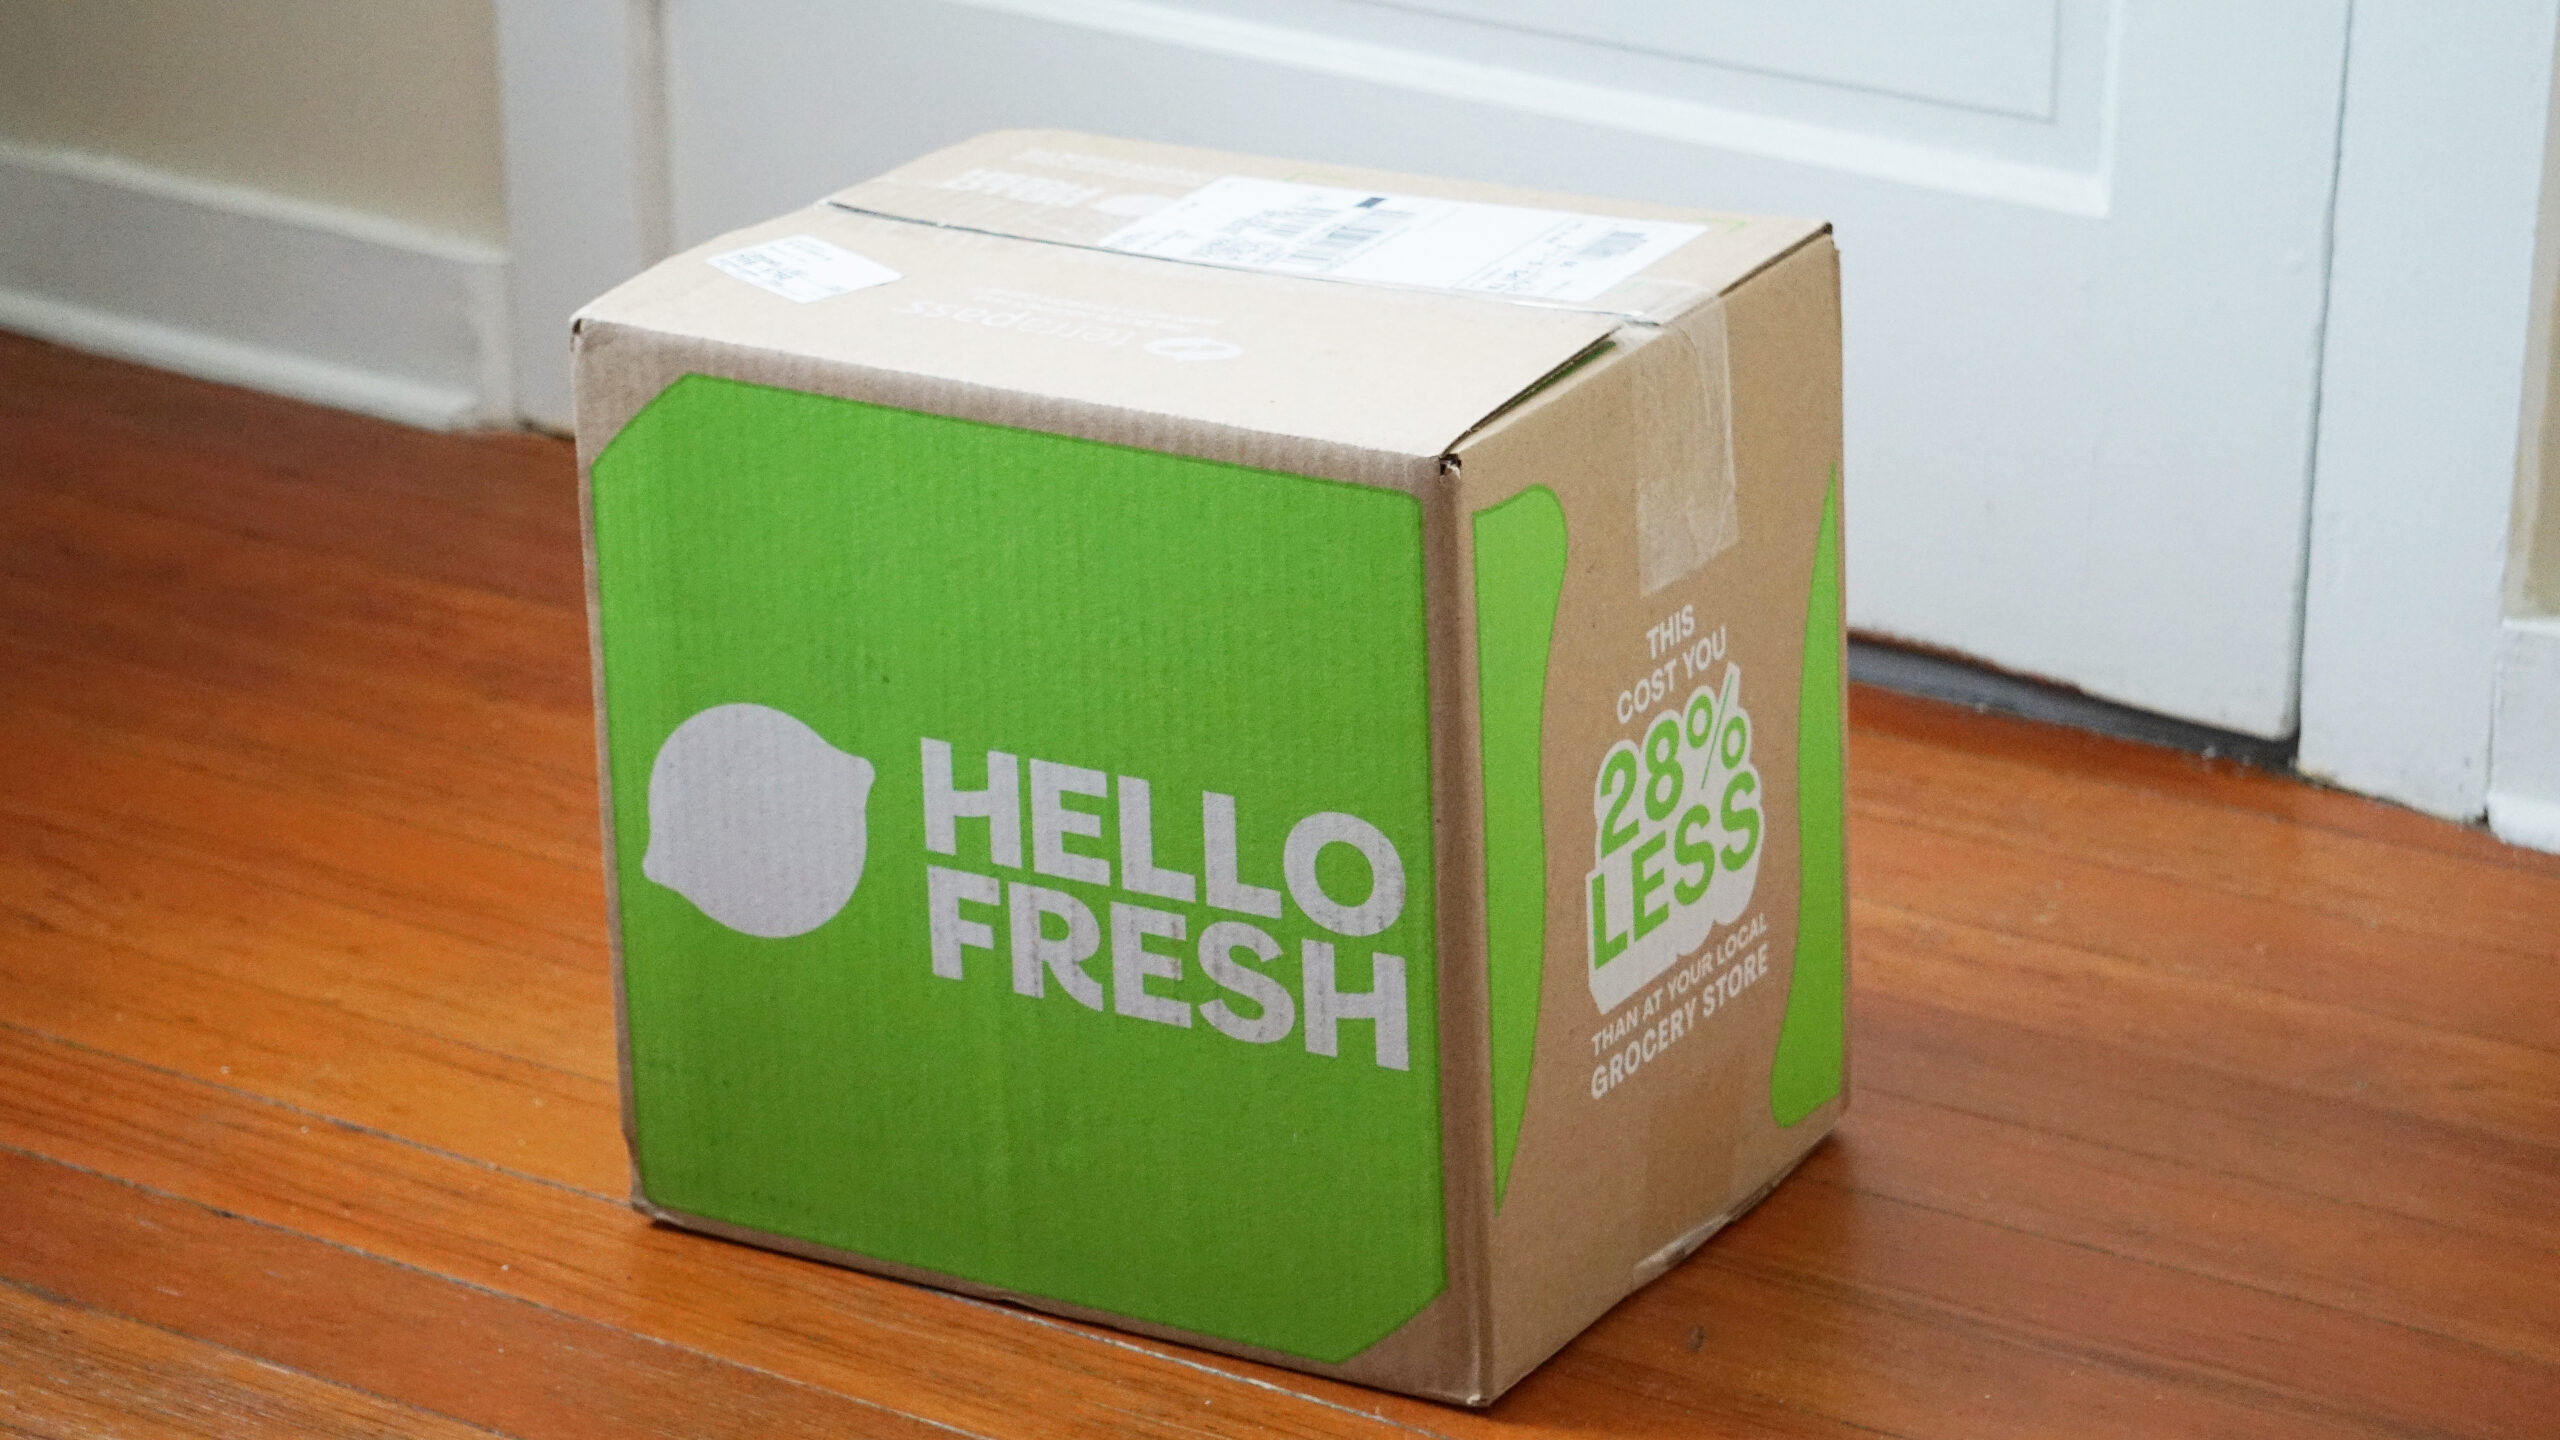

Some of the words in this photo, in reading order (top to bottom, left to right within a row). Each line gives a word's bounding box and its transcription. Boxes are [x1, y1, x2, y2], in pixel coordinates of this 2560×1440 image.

[1616, 658, 1677, 724] COST
[1682, 625, 1726, 679] YOU
[1646, 604, 1694, 660] THIS
[920, 737, 1406, 937] HELLO
[1600, 671, 1747, 860] 28%
[1591, 770, 1760, 970] LESS
[927, 864, 1410, 1071] FRESH
[1591, 1005, 1639, 1056] THAN
[1642, 988, 1664, 1022] AT
[1667, 951, 1714, 1001] YOUR
[1717, 912, 1768, 966] LOCAL
[1591, 997, 1697, 1100] GROCERY
[1702, 943, 1768, 1018] STORE
